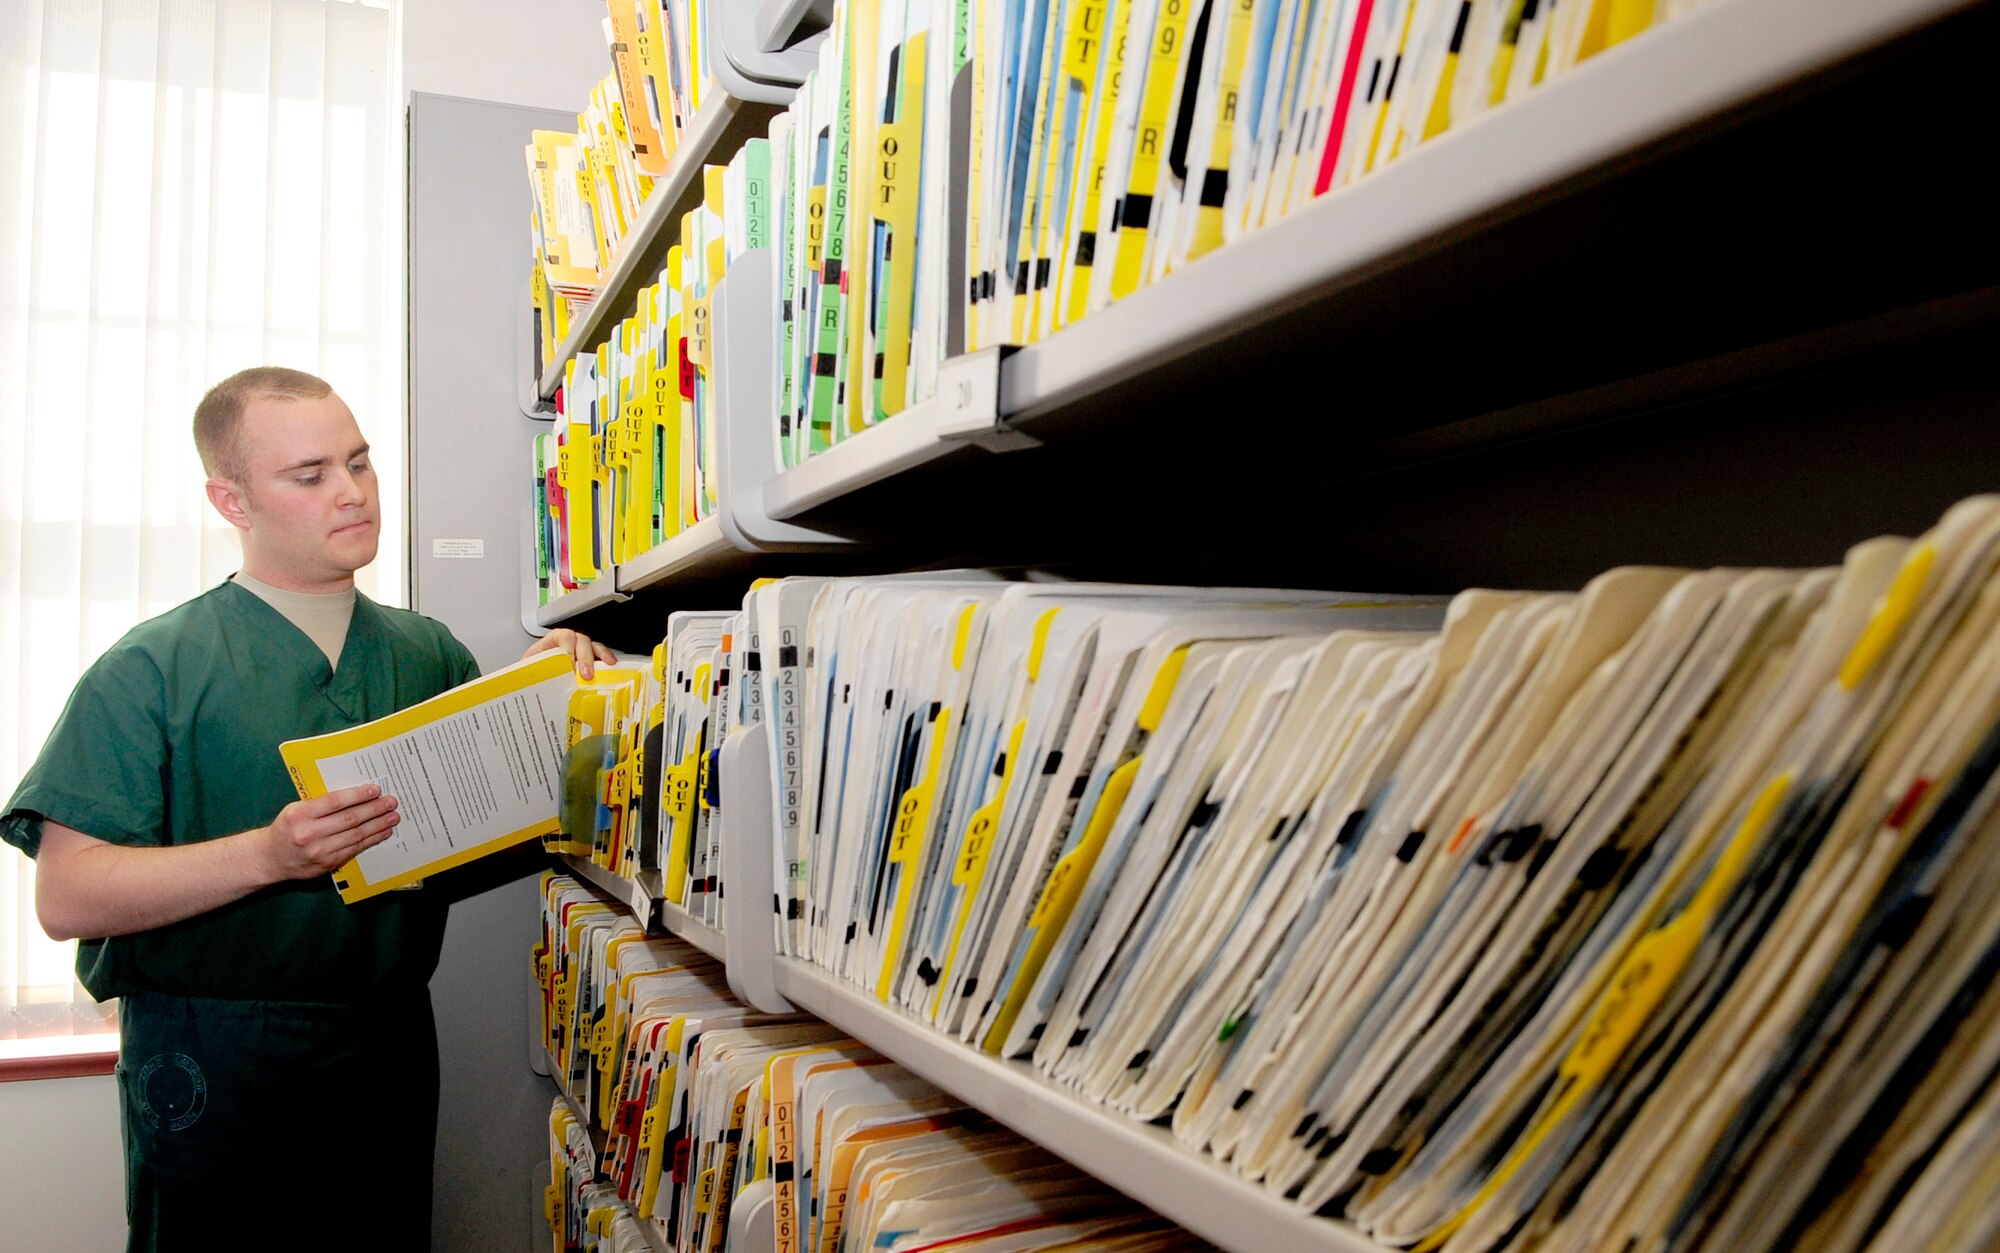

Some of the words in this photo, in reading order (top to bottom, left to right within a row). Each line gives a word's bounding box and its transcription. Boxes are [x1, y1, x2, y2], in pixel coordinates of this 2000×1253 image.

[1078, 0, 1101, 63] UT
[1161, 27, 1174, 54] 9
[638, 36, 650, 66] OUT
[1224, 92, 1237, 121] R
[1140, 129, 1158, 155] R
[838, 166, 848, 184] 5
[880, 137, 898, 204] OUT
[750, 182, 758, 196] 0
[836, 190, 846, 208] 6
[750, 202, 756, 214] 1
[750, 220, 758, 233] 2
[834, 214, 844, 232] 7
[808, 202, 823, 262] OUT
[832, 238, 842, 256] 8
[825, 309, 837, 328] R
[695, 307, 706, 352] OUT
[656, 378, 666, 416] OUT
[634, 406, 643, 442] OUT
[608, 430, 618, 462] OUT
[593, 442, 601, 474] OUT
[560, 452, 569, 481] OUT
[752, 635, 760, 648] 0
[783, 630, 791, 644] 0
[752, 672, 760, 685] 2
[784, 670, 792, 684] 2
[752, 690, 760, 703] 3
[785, 690, 794, 705] 3
[752, 709, 760, 722] 4
[786, 710, 794, 724] 4
[786, 731, 795, 746] 5
[787, 751, 796, 766] 6
[616, 768, 626, 797] OUT
[788, 771, 796, 785] 7
[298, 782, 304, 790] 2
[302, 791, 308, 799] 3
[675, 780, 688, 811] OUT
[788, 791, 796, 806] 8
[789, 811, 797, 826] 9
[896, 798, 918, 850] OUT
[964, 818, 989, 872] OUT
[790, 864, 798, 878] R
[540, 963, 548, 986] OUT
[558, 998, 566, 1020] OUT
[582, 1018, 591, 1044] OUT
[736, 1105, 745, 1114] 0
[778, 1106, 787, 1120] 0
[642, 1116, 654, 1143] OUT
[736, 1118, 742, 1127] 1
[779, 1126, 786, 1140] 1
[779, 1146, 788, 1160] 2
[702, 1172, 715, 1203] OUT
[780, 1184, 788, 1198] 4
[838, 1193, 846, 1203] 0
[781, 1203, 789, 1217] 5
[781, 1222, 789, 1236] 6
[834, 1226, 841, 1235] 2
[781, 1241, 789, 1253] 7
